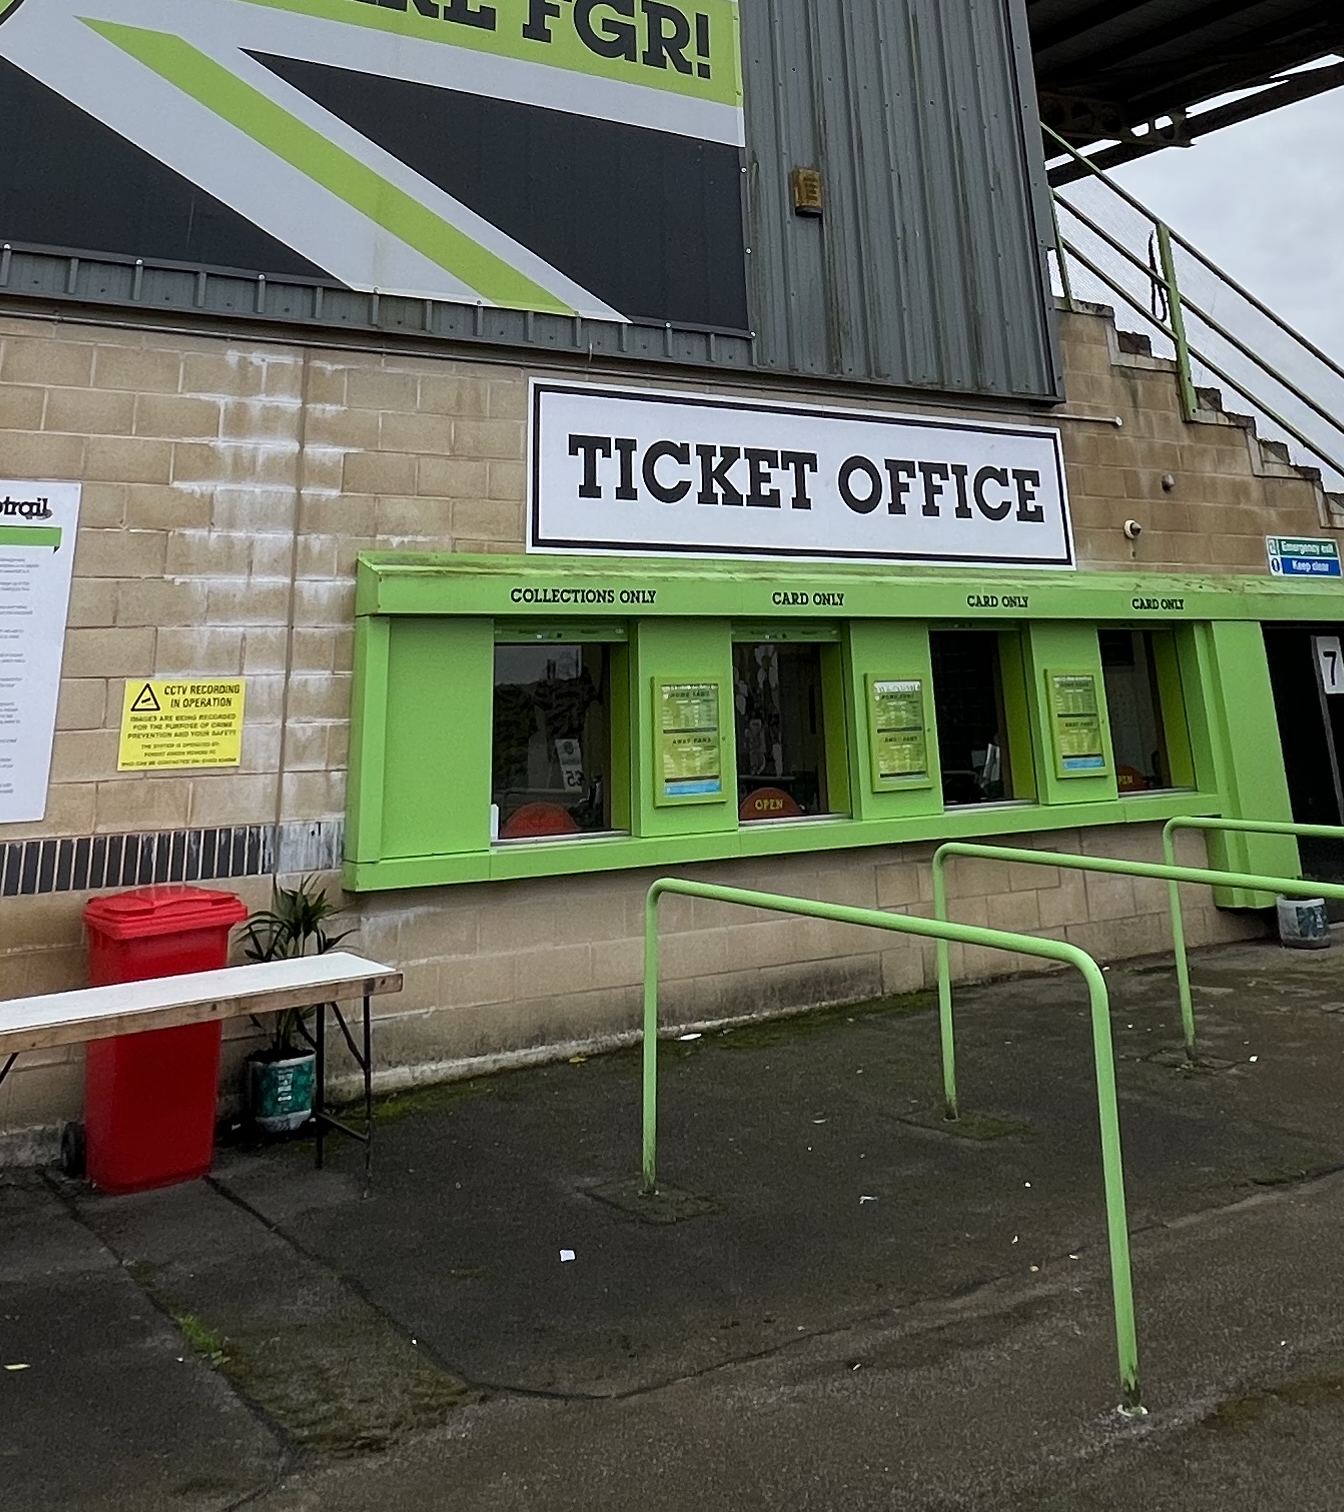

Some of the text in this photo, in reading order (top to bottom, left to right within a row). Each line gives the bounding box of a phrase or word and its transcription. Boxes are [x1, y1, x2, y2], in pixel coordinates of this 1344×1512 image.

[568, 433, 1045, 524] TICKET OFFICE
[510, 588, 657, 605] COLLECTIONS ONLY
[772, 591, 845, 607] CARD ONLY
[966, 595, 1029, 609] CARD ONLY
[1132, 597, 1185, 610] CARD ONLY
[1323, 650, 1338, 686] 7
[164, 684, 240, 696] CCTV RECORDING
[170, 698, 232, 708] IN OPERATION
[755, 798, 784, 812] OPEN
